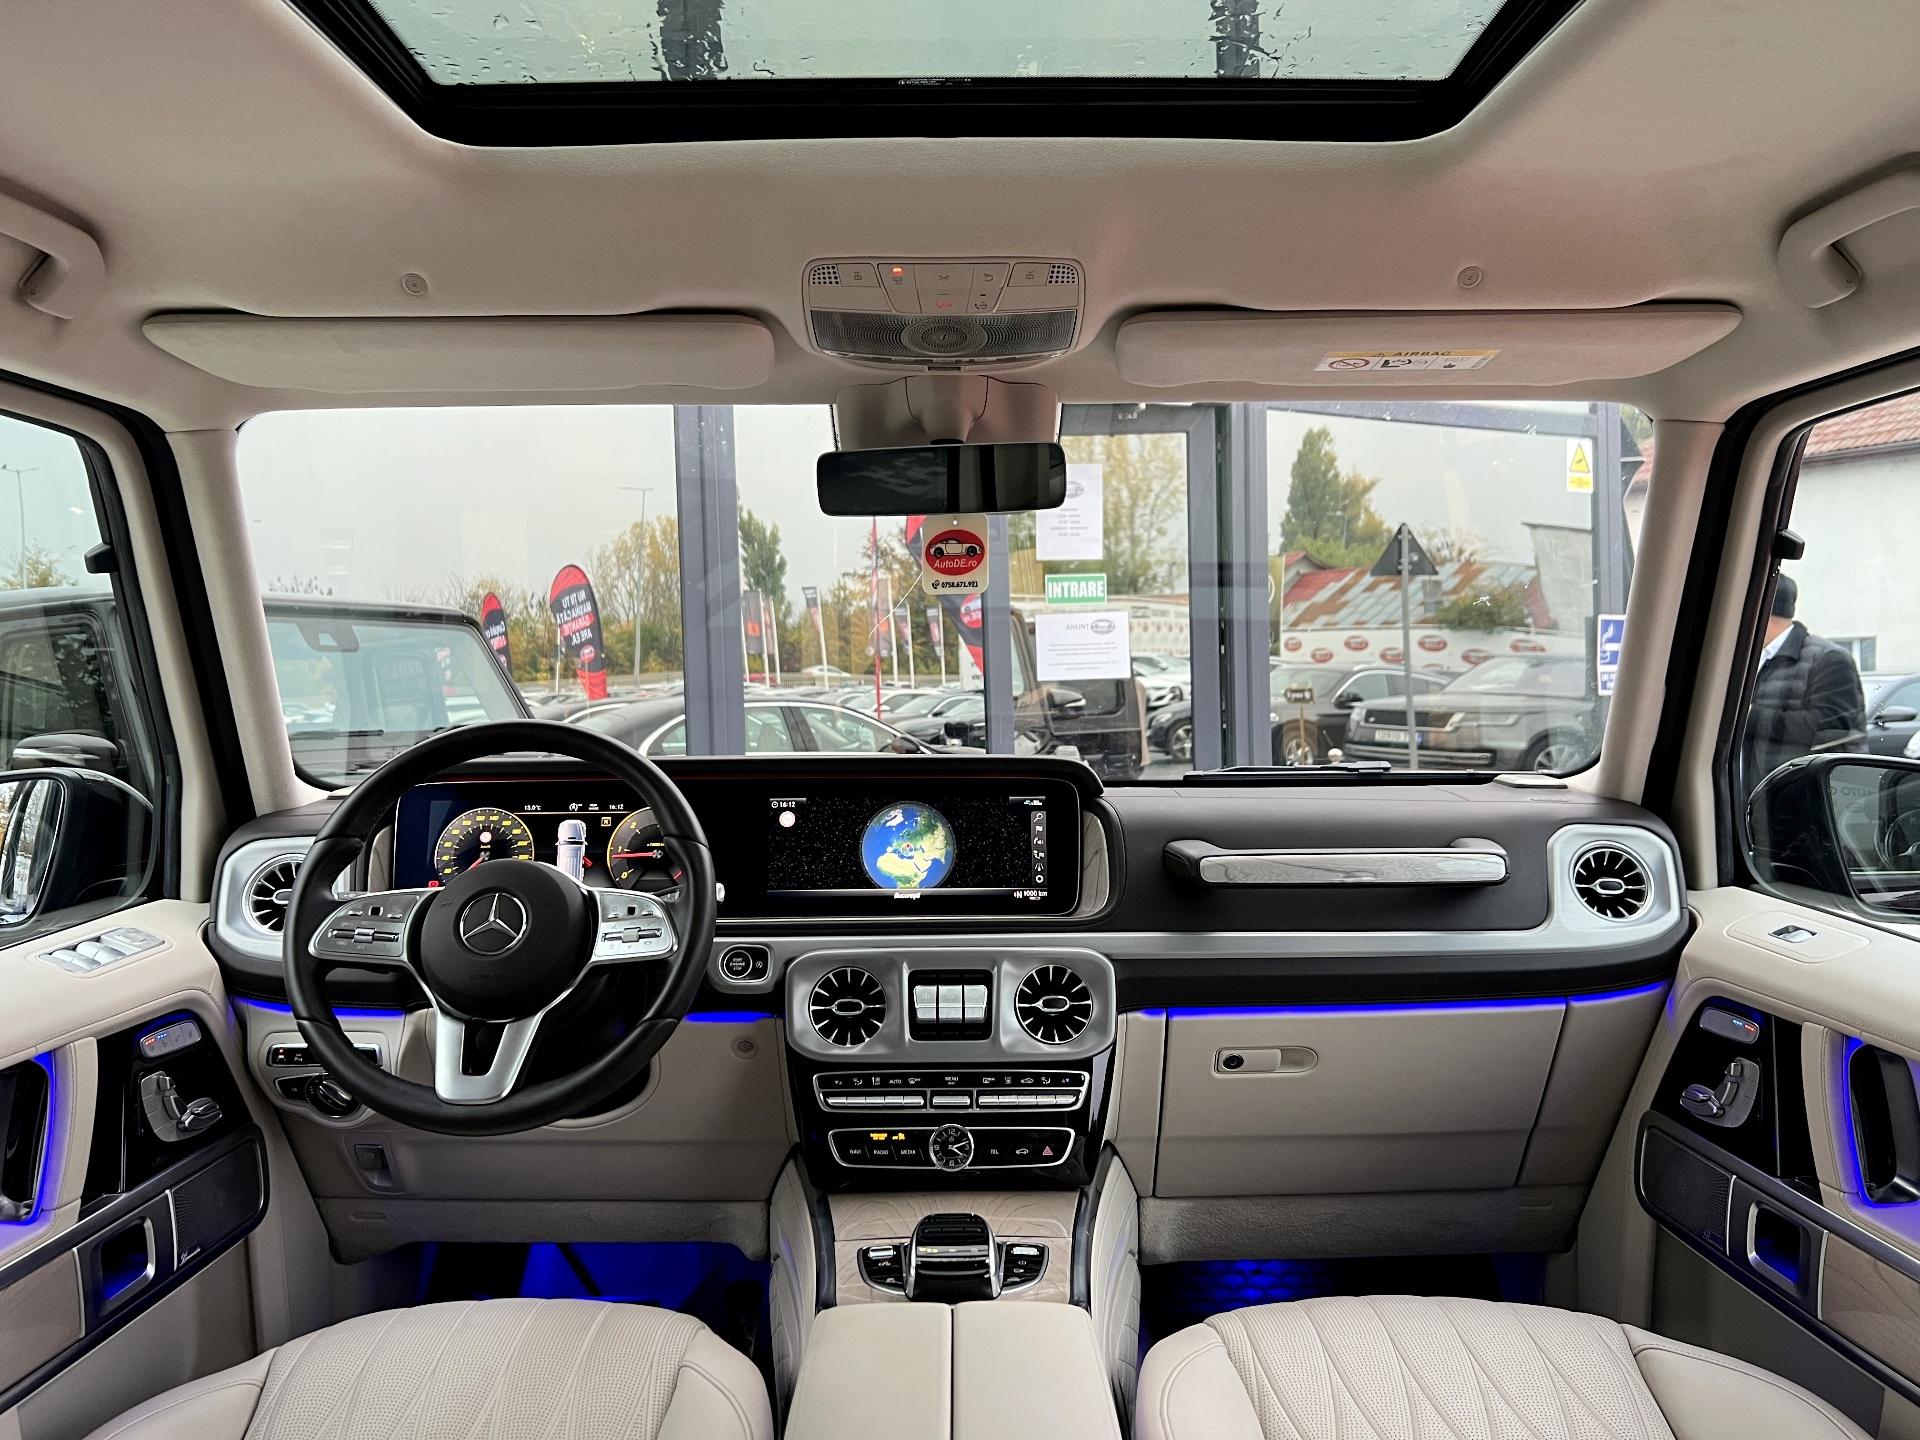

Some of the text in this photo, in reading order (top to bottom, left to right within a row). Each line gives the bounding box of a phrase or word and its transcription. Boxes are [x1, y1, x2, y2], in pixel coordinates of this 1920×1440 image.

[933, 558, 978, 568] AutoDE.ro
[1048, 581, 1104, 598] INTRARE
[630, 821, 637, 829] 2
